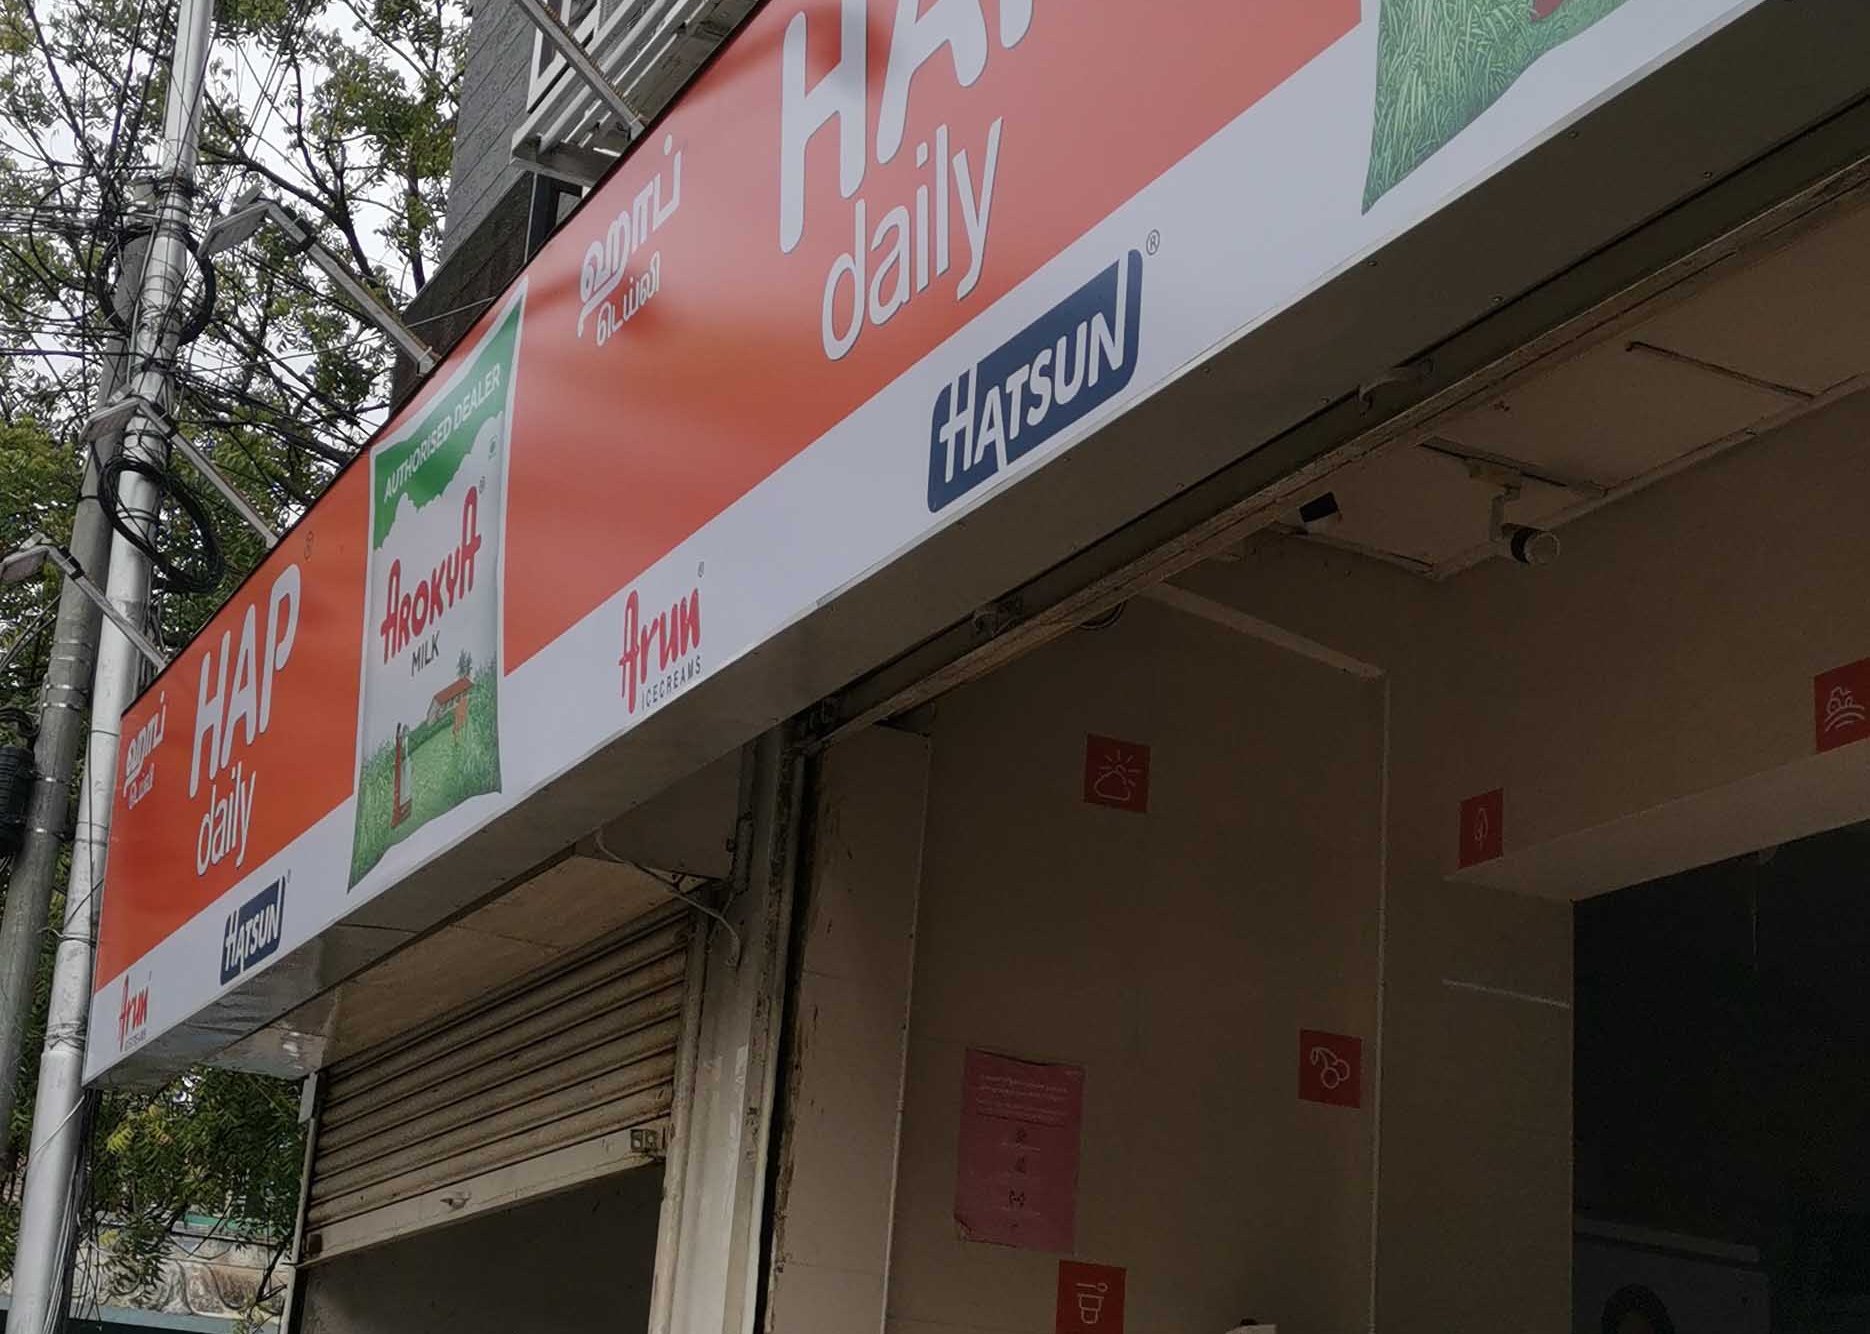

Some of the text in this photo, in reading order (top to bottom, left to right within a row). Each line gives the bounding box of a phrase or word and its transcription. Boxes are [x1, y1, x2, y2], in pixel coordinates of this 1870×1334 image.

[822, 116, 1003, 361] daily
[939, 254, 1129, 483] HATSUN
[384, 363, 500, 504] AUTHORISED DEALER
[189, 564, 300, 799] HAP
[412, 631, 440, 676] MILK
[619, 588, 701, 714] Arun
[641, 655, 702, 710] ICECREAMS
[197, 761, 256, 876] daily
[225, 876, 283, 972] HATSUN
